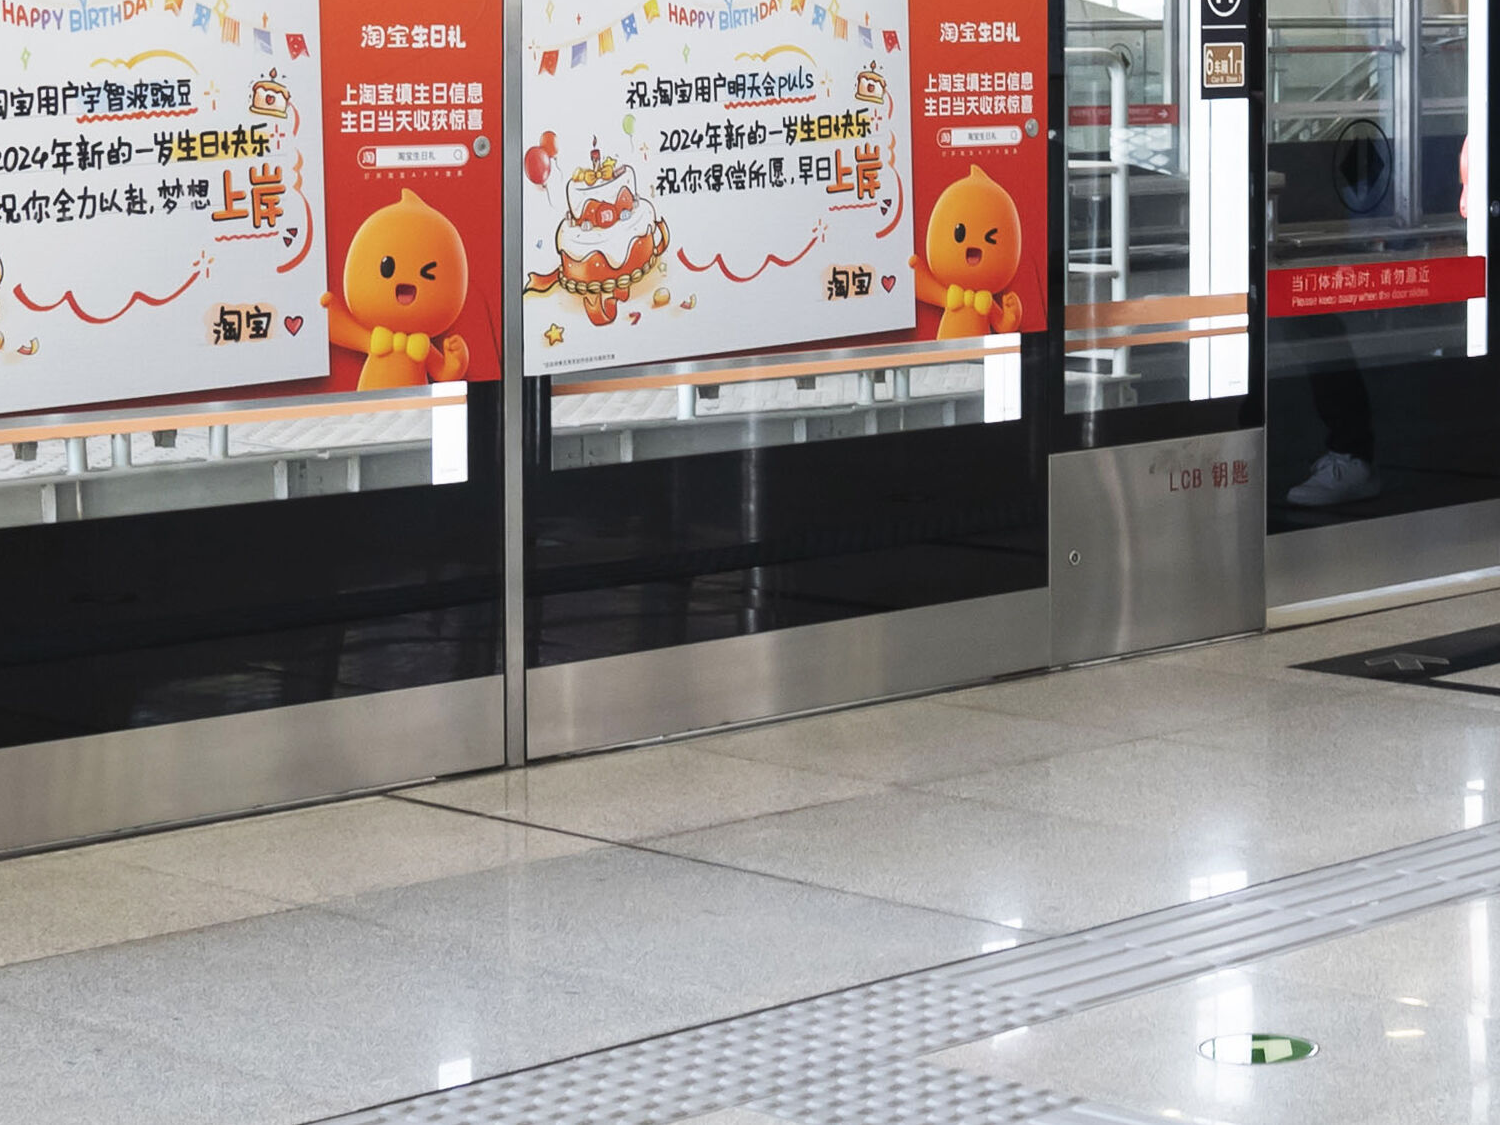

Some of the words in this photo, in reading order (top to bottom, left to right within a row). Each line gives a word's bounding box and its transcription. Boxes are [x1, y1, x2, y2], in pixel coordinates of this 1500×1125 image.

[2, 0, 63, 30] HAPPY
[668, 2, 715, 28] HAPPY
[361, 25, 466, 49] 淘宝生日礼
[940, 22, 1020, 43] 淘宝生日礼
[341, 82, 483, 106] 上淘宝填生日信息
[341, 109, 483, 133] 生日当天收获惊喜
[659, 107, 872, 154] 2024年新的一岁生日快乐
[827, 267, 872, 301] 淘宝
[213, 305, 272, 344] 淘宝
[1170, 468, 1202, 492] LCB
